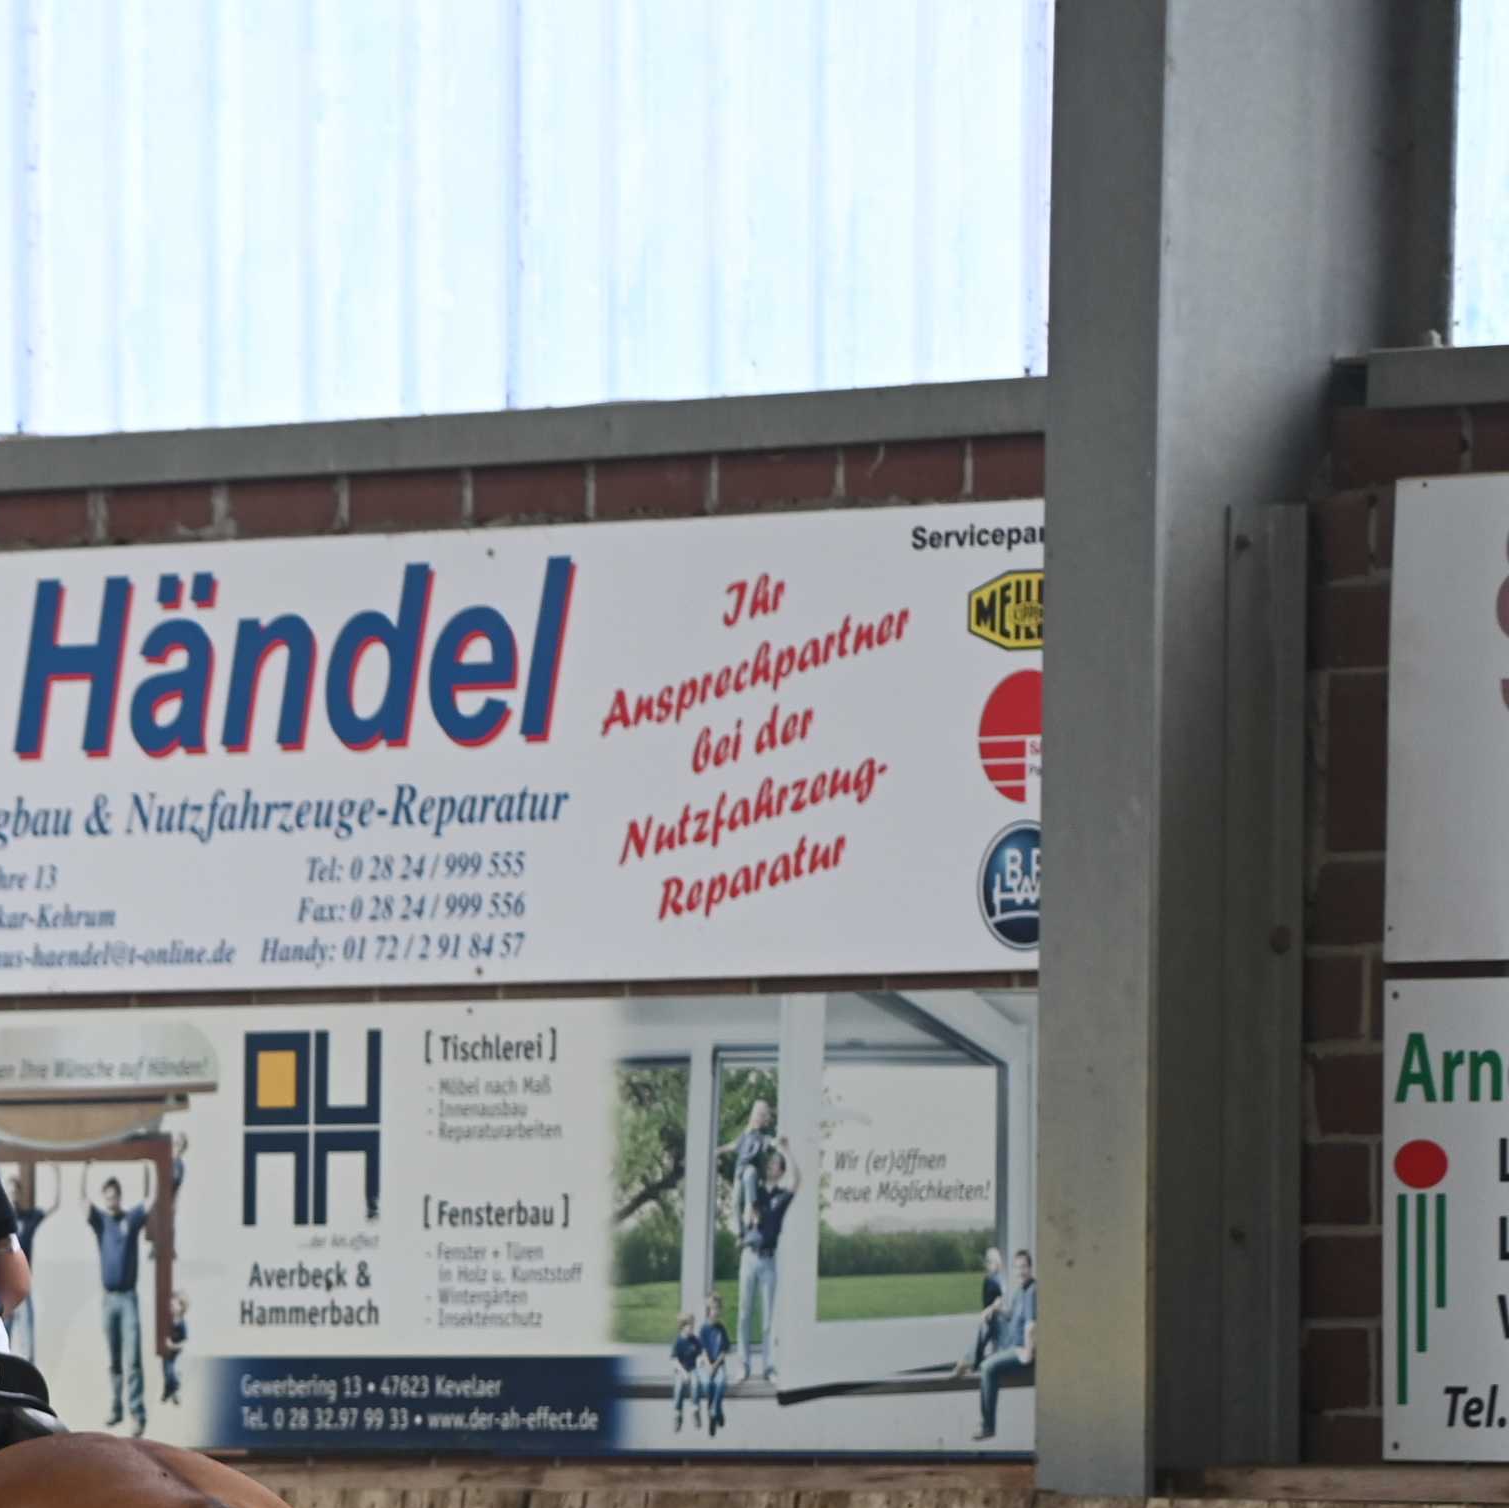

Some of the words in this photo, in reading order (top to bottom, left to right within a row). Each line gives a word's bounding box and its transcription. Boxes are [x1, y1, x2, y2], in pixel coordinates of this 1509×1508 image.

[722, 572, 786, 629] Ihr
[14, 554, 578, 761] Händel
[601, 607, 910, 738] Ansprechpartner
[692, 717, 744, 775] bei
[755, 704, 815, 755] der
[84, 793, 112, 836] &
[125, 782, 570, 843] Nutzfahrzeuge-Reparatur
[619, 756, 888, 866] Nutzfahrzeug-
[34, 864, 59, 891] 13
[306, 855, 343, 884] Tel:
[369, 855, 394, 882] 28
[400, 854, 426, 881] 24
[444, 852, 482, 879] 999
[488, 850, 526, 878] 555
[658, 834, 848, 921] Reparatur
[297, 896, 347, 924] Fax:
[369, 895, 394, 922] 28
[400, 894, 426, 921] 24
[444, 892, 483, 918] 999
[488, 891, 526, 919] 556
[259, 936, 336, 968] Handy:
[439, 1032, 544, 1062] Tischlerei
[1394, 1031, 1509, 1104] Arn
[437, 1198, 555, 1228] Fensterbau
[248, 1261, 347, 1290] Averbeck
[355, 1260, 372, 1288] &
[239, 1299, 380, 1327] Hammerbach
[239, 1373, 338, 1402] Gewerbering
[341, 1375, 363, 1398] 13
[434, 1373, 502, 1398] Kevelaer
[1442, 1383, 1508, 1429] Tel.
